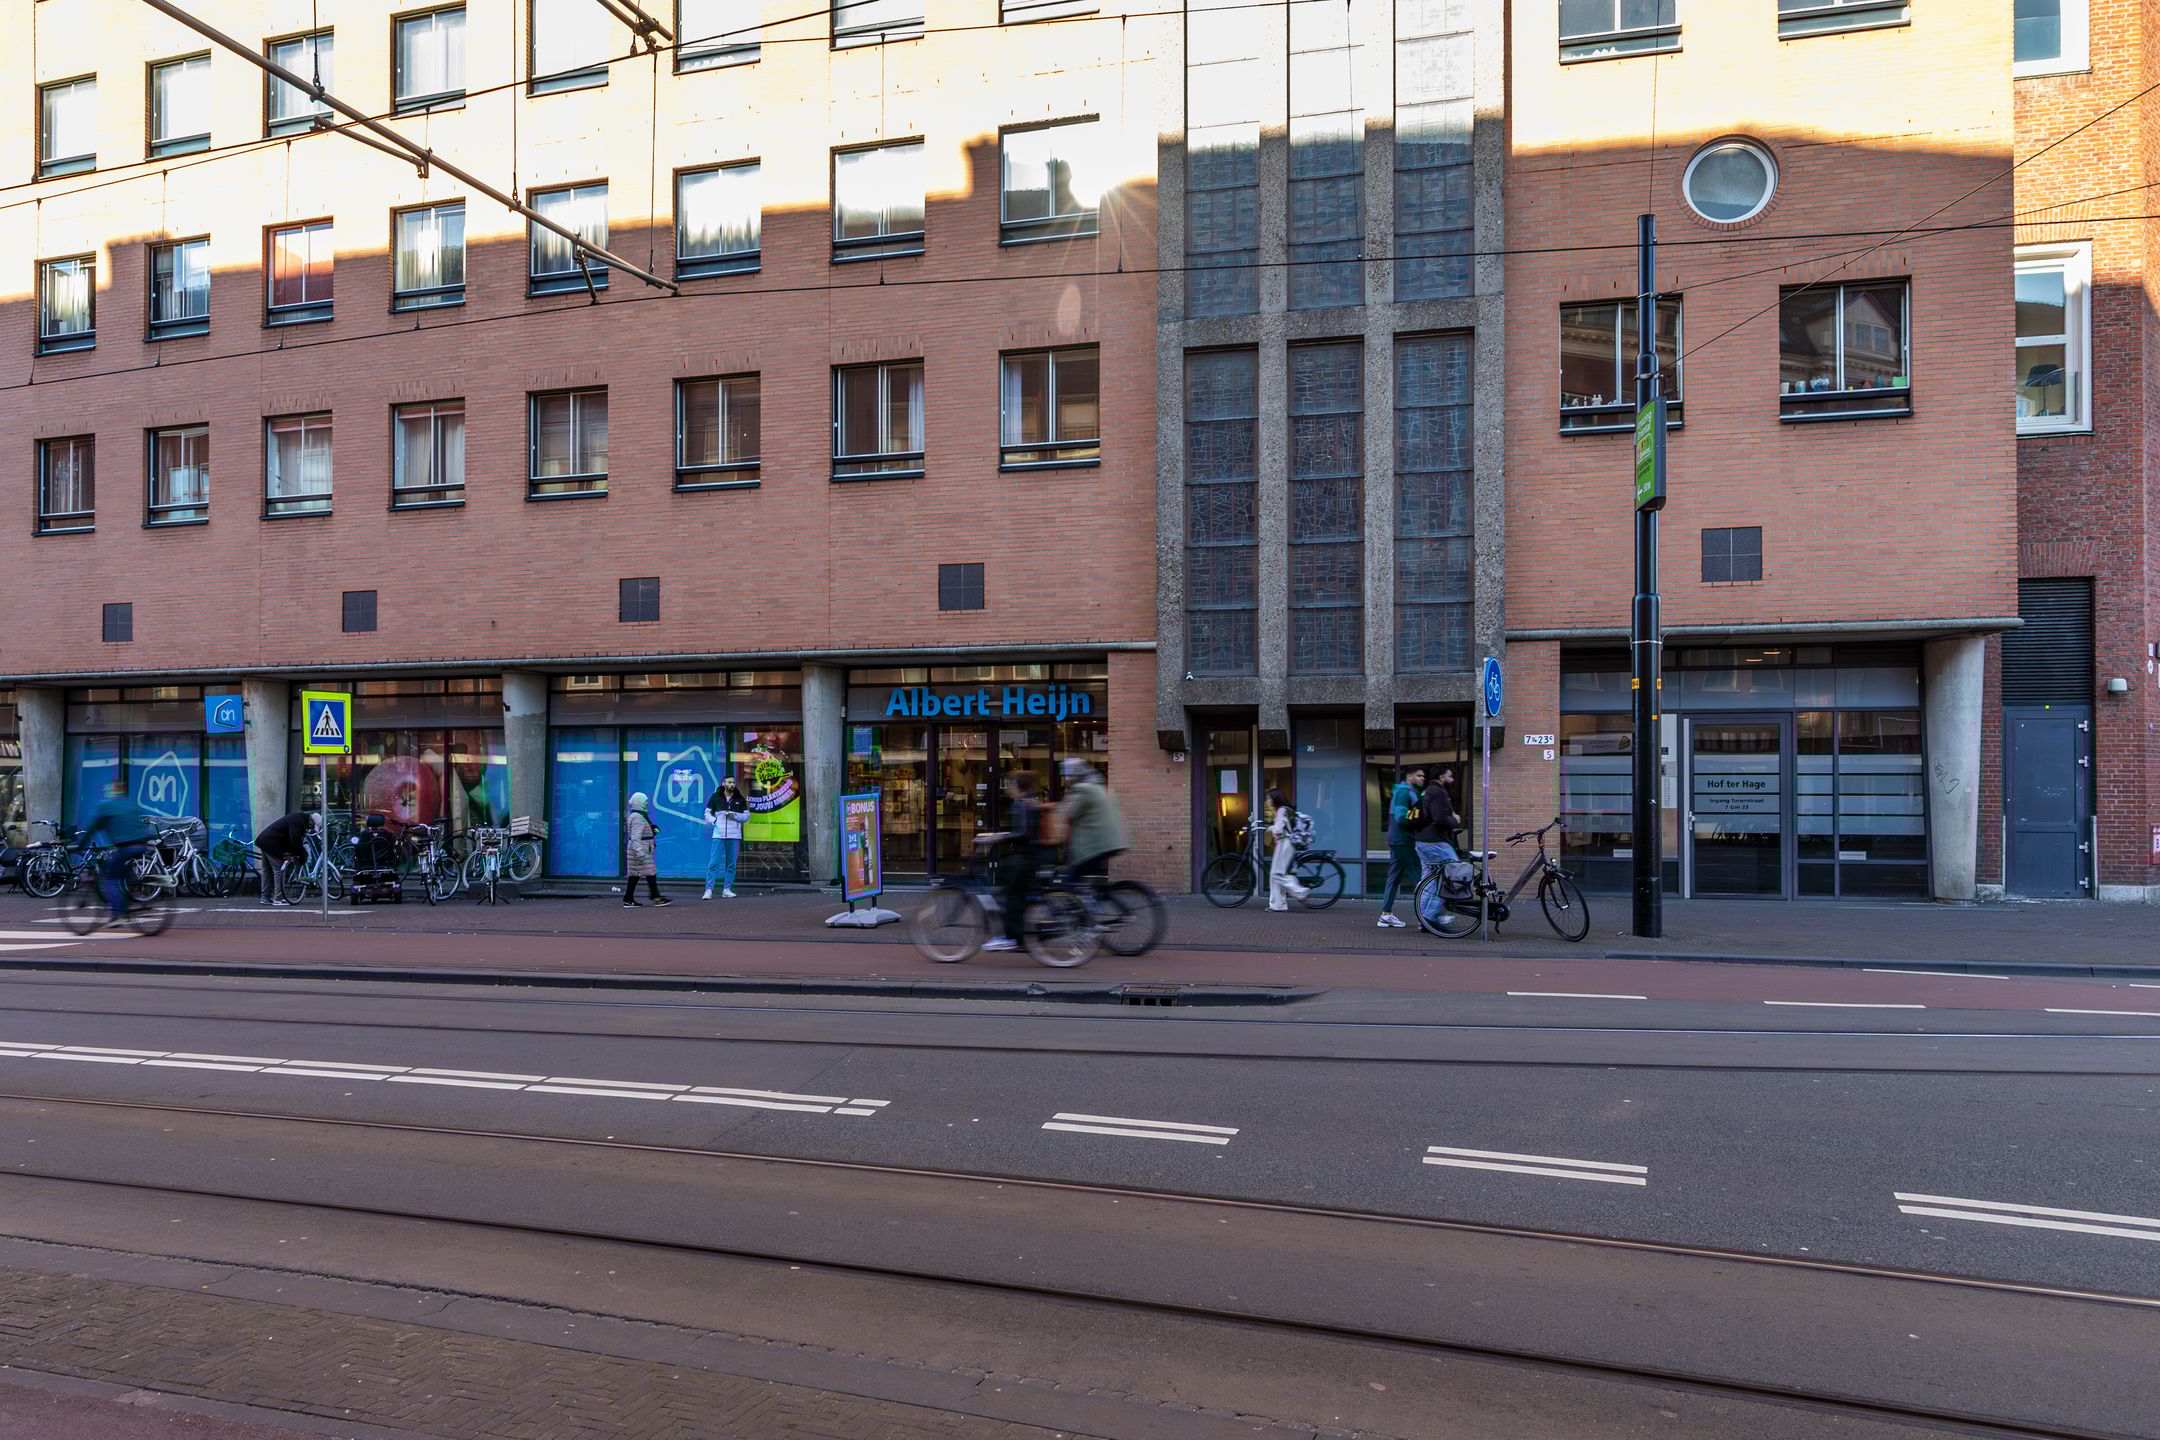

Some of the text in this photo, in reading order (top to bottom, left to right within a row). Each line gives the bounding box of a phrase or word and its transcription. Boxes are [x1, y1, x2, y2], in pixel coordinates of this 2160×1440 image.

[885, 684, 1091, 722] Albert Heijn
[1707, 780, 1766, 789] Hof ter Hage
[851, 801, 875, 814] BONUS
[848, 833, 858, 843] 1+1
